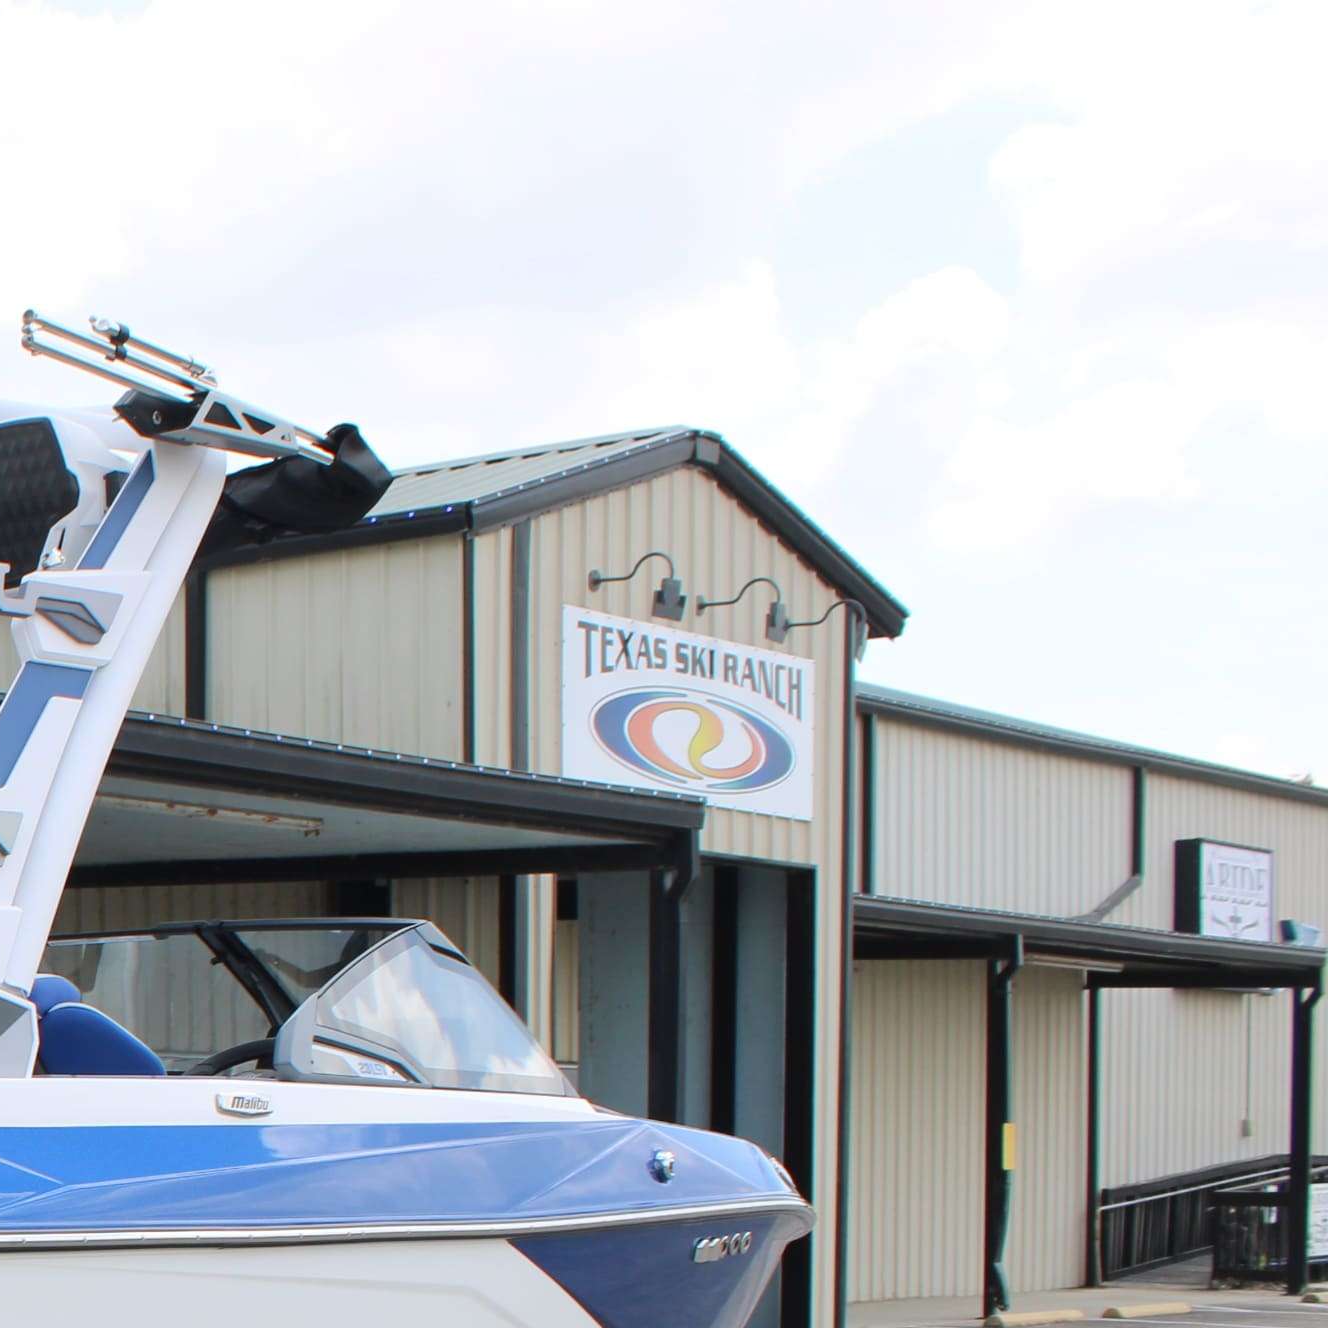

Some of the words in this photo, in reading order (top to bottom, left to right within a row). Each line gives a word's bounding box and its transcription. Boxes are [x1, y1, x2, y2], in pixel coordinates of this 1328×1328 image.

[577, 620, 668, 678] TEXAS
[675, 642, 716, 680] SKI
[723, 652, 803, 721] RANCH
[230, 1095, 269, 1110] Malibu
